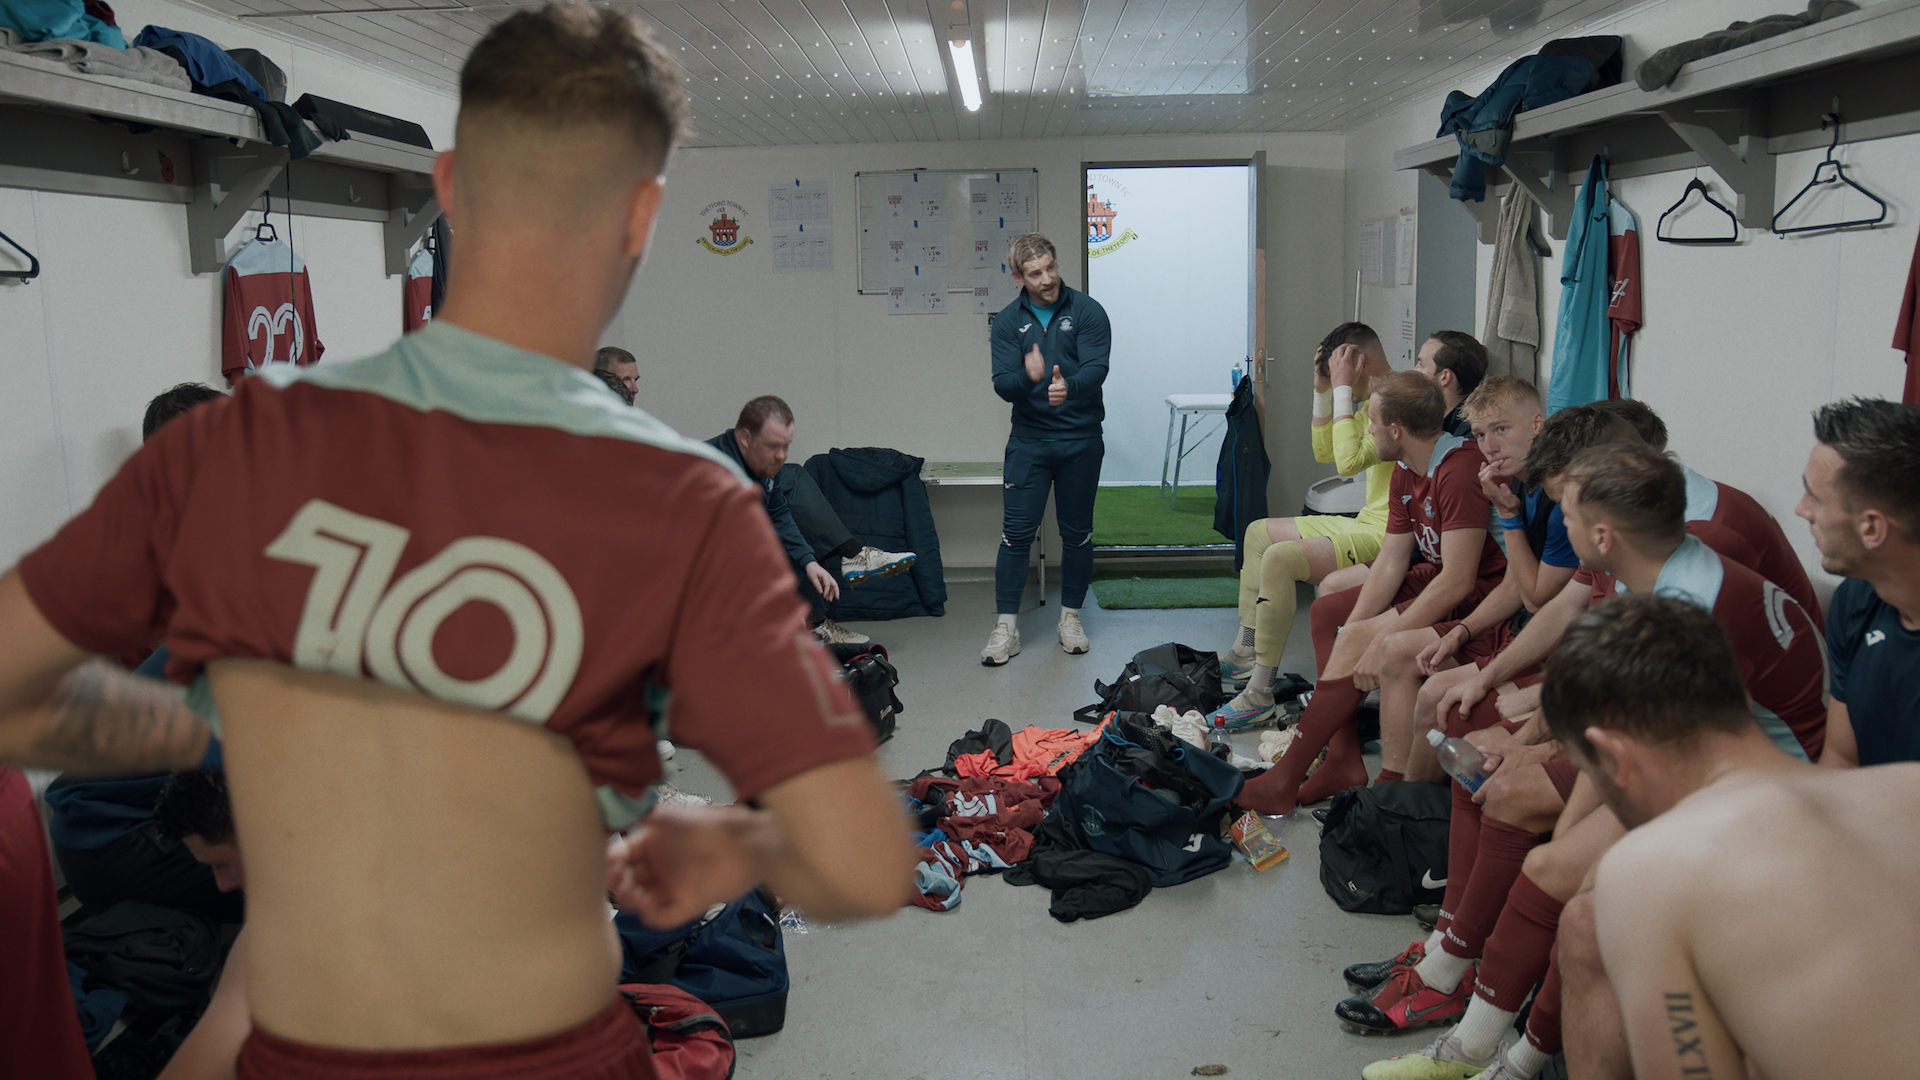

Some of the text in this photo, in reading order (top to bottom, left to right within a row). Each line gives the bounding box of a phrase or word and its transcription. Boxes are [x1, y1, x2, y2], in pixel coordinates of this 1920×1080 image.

[699, 200, 749, 218] THETFORD TOWN FC
[1098, 173, 1122, 189] TOWN
[1120, 186, 1132, 198] FC
[266, 498, 584, 724] 10
[1664, 993, 1712, 1080] LXVII
